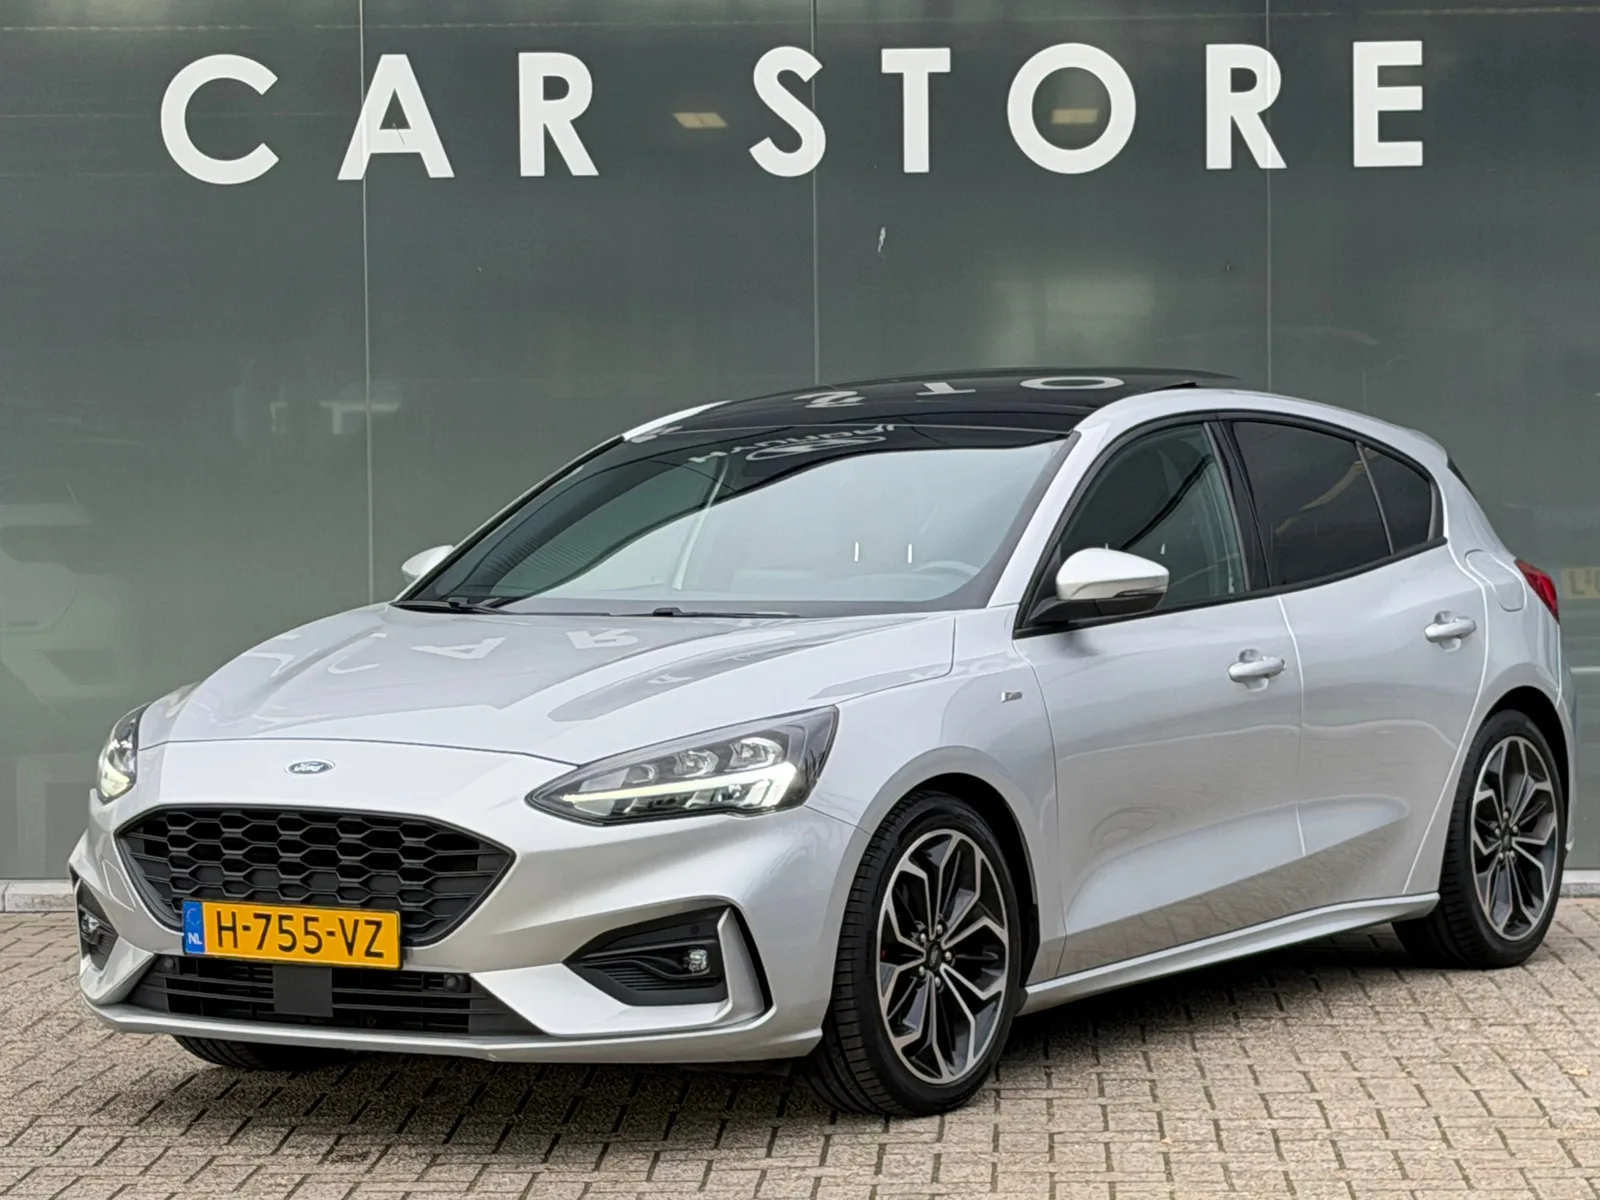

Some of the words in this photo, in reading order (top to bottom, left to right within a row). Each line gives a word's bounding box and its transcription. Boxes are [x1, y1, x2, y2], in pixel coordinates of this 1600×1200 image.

[161, 53, 598, 185] CAR
[750, 41, 1423, 177] STORE
[187, 931, 204, 945] NL
[216, 910, 385, 959] H-755-VZ
